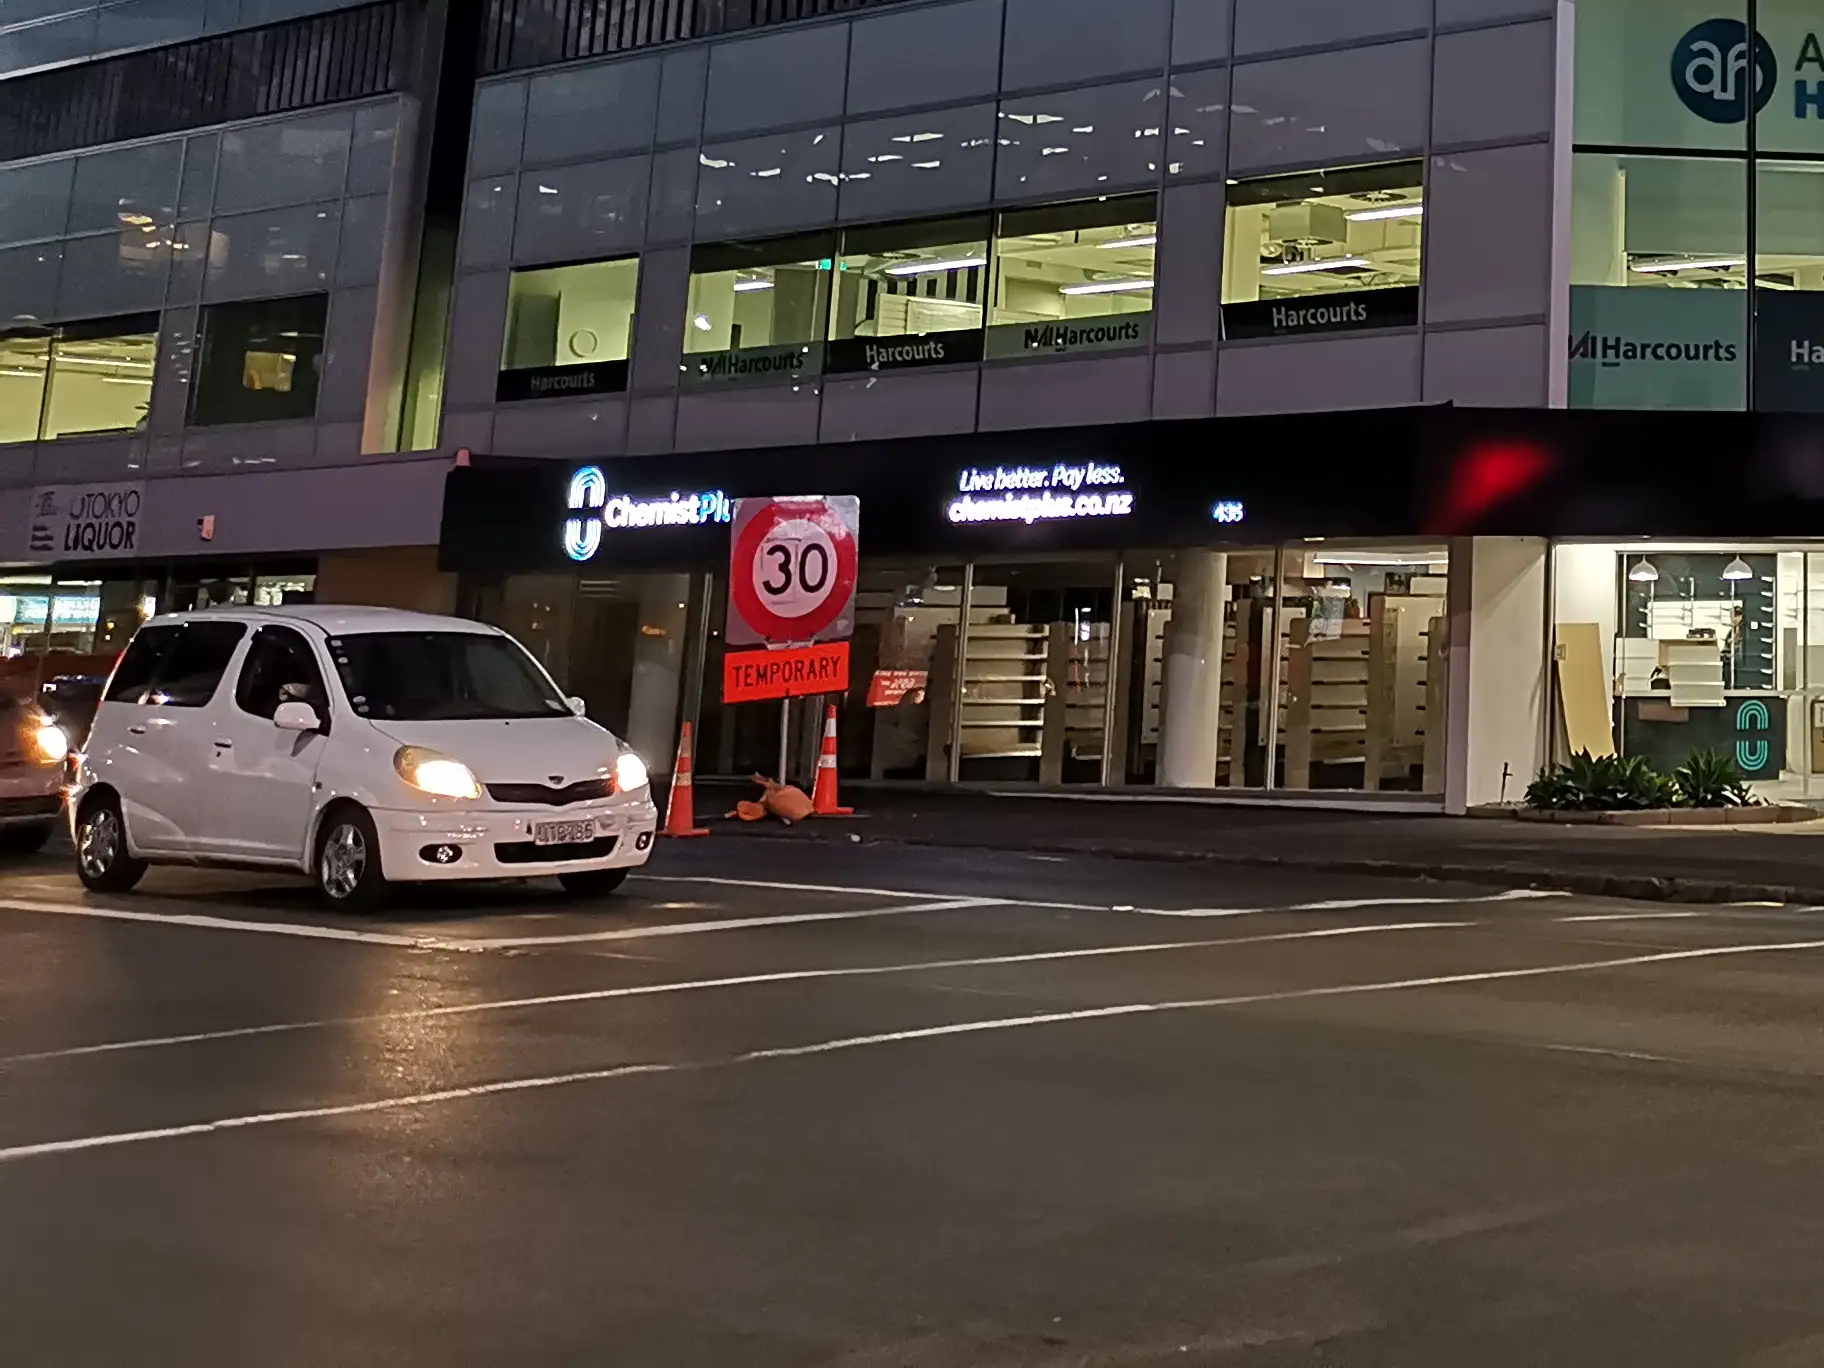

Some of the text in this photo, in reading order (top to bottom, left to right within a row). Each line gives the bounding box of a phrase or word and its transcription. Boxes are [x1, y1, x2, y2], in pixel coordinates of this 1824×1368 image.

[1273, 302, 1367, 329] Harcourts
[1055, 321, 1140, 346] Harcourts
[866, 341, 945, 364] Harcourts
[1602, 336, 1736, 362] Harcourts
[728, 351, 804, 375] Harcourts
[530, 372, 596, 391] Harcourts
[959, 462, 1125, 492] Live better. Pay less.
[604, 490, 731, 528] ChemistPlu
[63, 520, 137, 552] LIQUOR
[762, 543, 829, 595] 30
[732, 655, 842, 698] TEMPORARY
